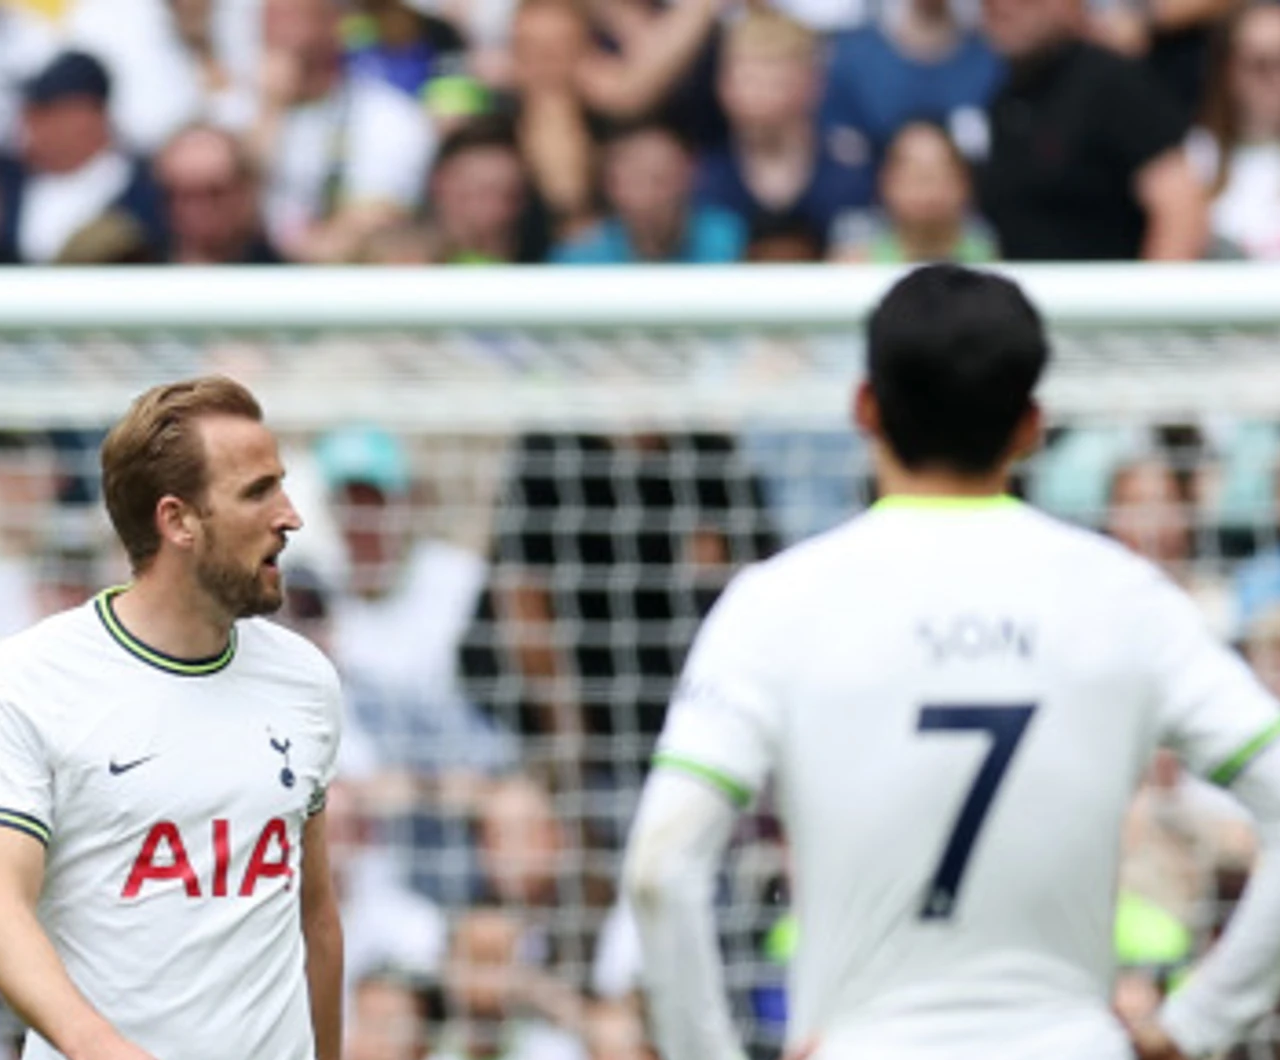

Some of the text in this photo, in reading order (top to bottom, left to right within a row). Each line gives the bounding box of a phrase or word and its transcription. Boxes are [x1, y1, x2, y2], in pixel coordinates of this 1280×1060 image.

[914, 615, 1037, 663] SON
[916, 702, 1043, 920] 7
[121, 818, 294, 899] AIA
